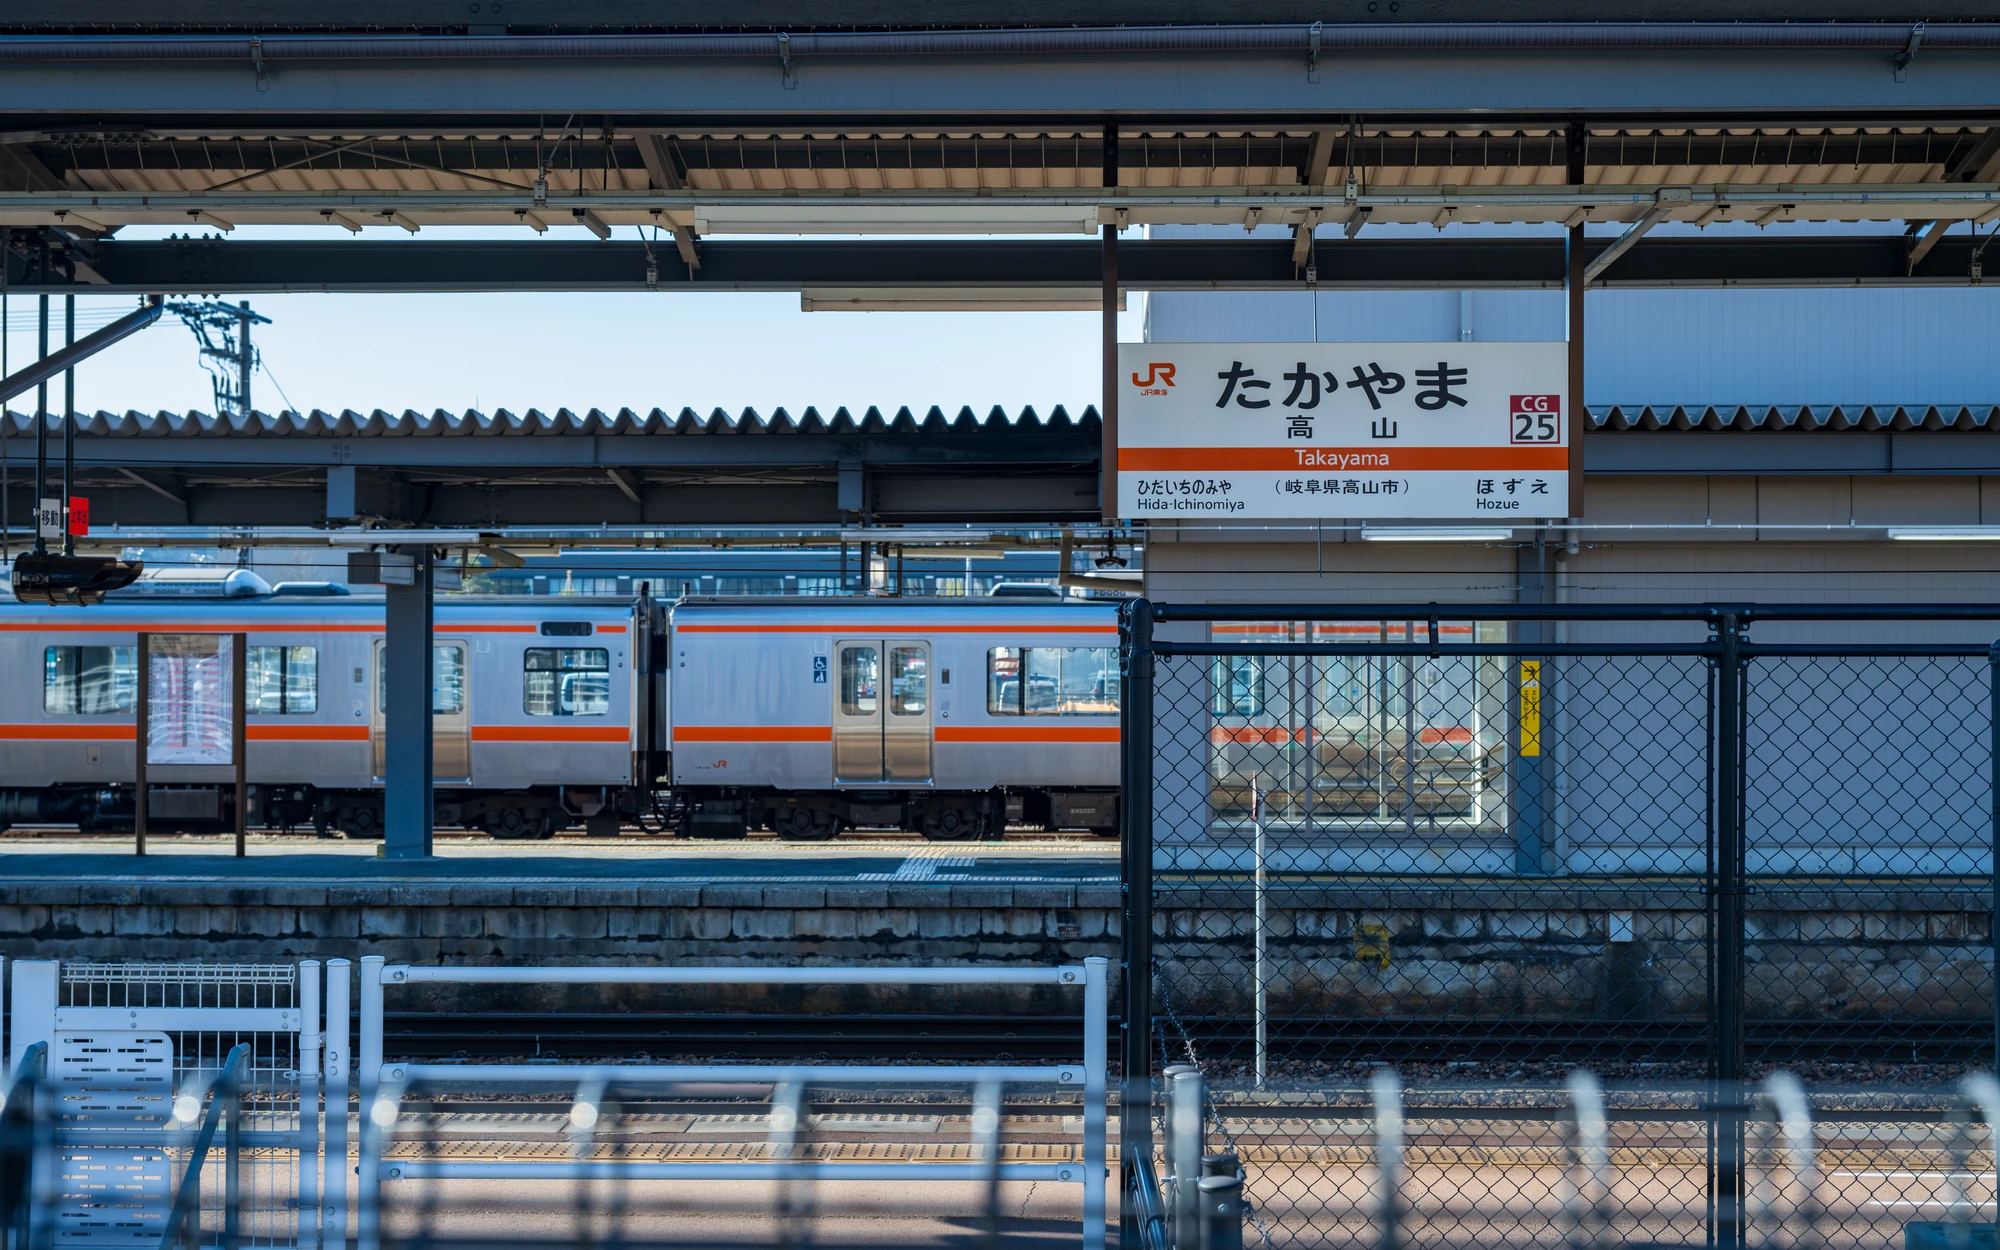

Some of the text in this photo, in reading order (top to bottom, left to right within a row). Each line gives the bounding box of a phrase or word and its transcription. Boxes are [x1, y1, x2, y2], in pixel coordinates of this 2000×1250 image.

[1132, 363, 1176, 387] JR
[1215, 360, 1469, 411] たかやま
[1520, 396, 1548, 412] CG
[1514, 415, 1555, 441] 25
[1294, 449, 1390, 470] Takayama
[1137, 479, 1232, 496] ひだいちのみや
[1476, 478, 1549, 495] ほずえ
[1137, 497, 1245, 513] Hida-Ichinomiya
[1476, 497, 1520, 511] Hozue
[42, 509, 58, 526] 移動
[713, 760, 727, 768] JR
